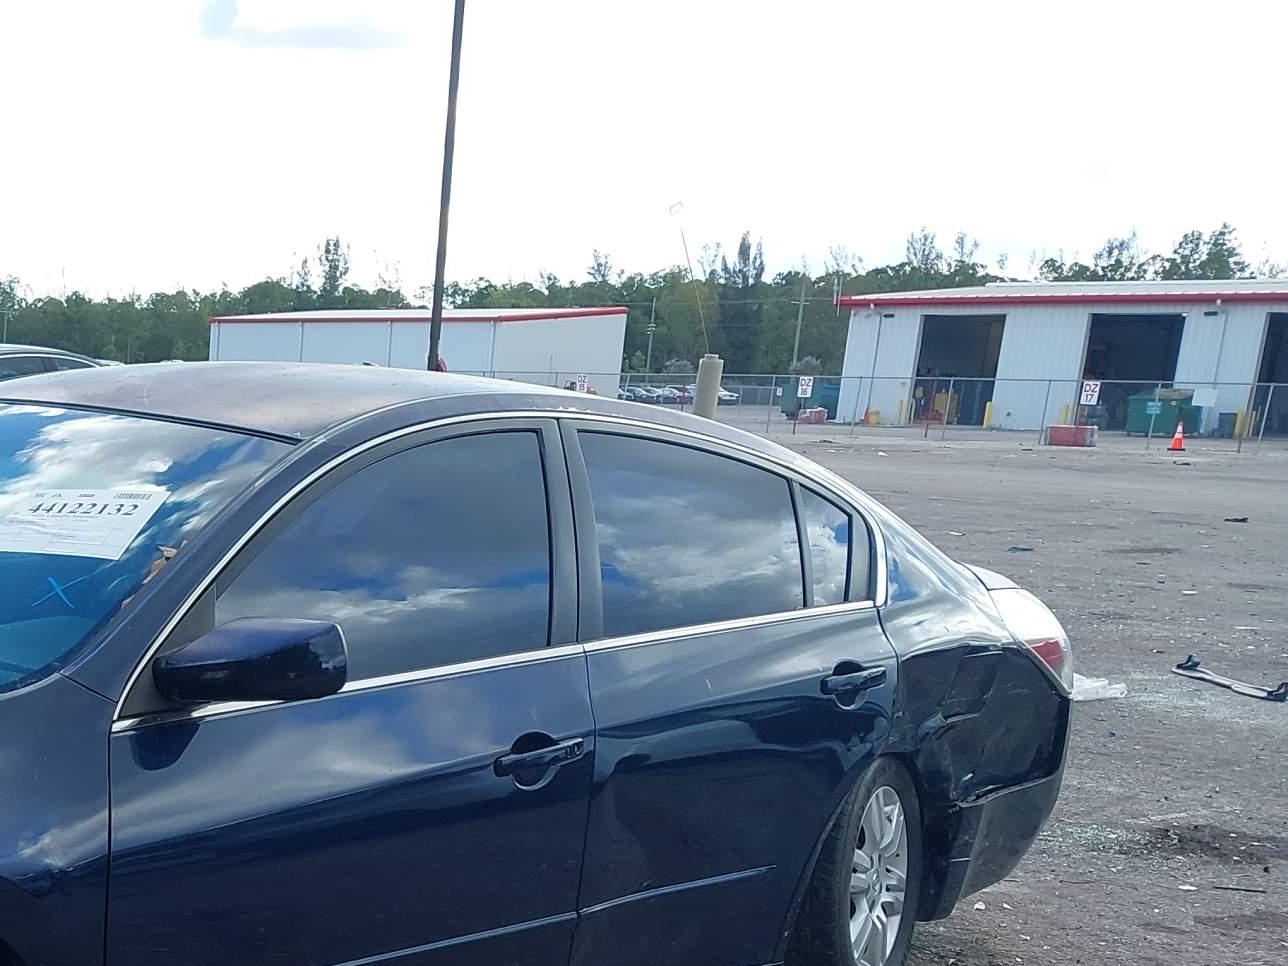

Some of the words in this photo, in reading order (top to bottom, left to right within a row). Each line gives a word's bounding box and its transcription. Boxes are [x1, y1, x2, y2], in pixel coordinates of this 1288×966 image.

[800, 378, 812, 387] DZ
[800, 387, 808, 396] 16
[1084, 383, 1099, 393] DZ
[1085, 393, 1095, 403] 17
[28, 501, 139, 516] 44122132
